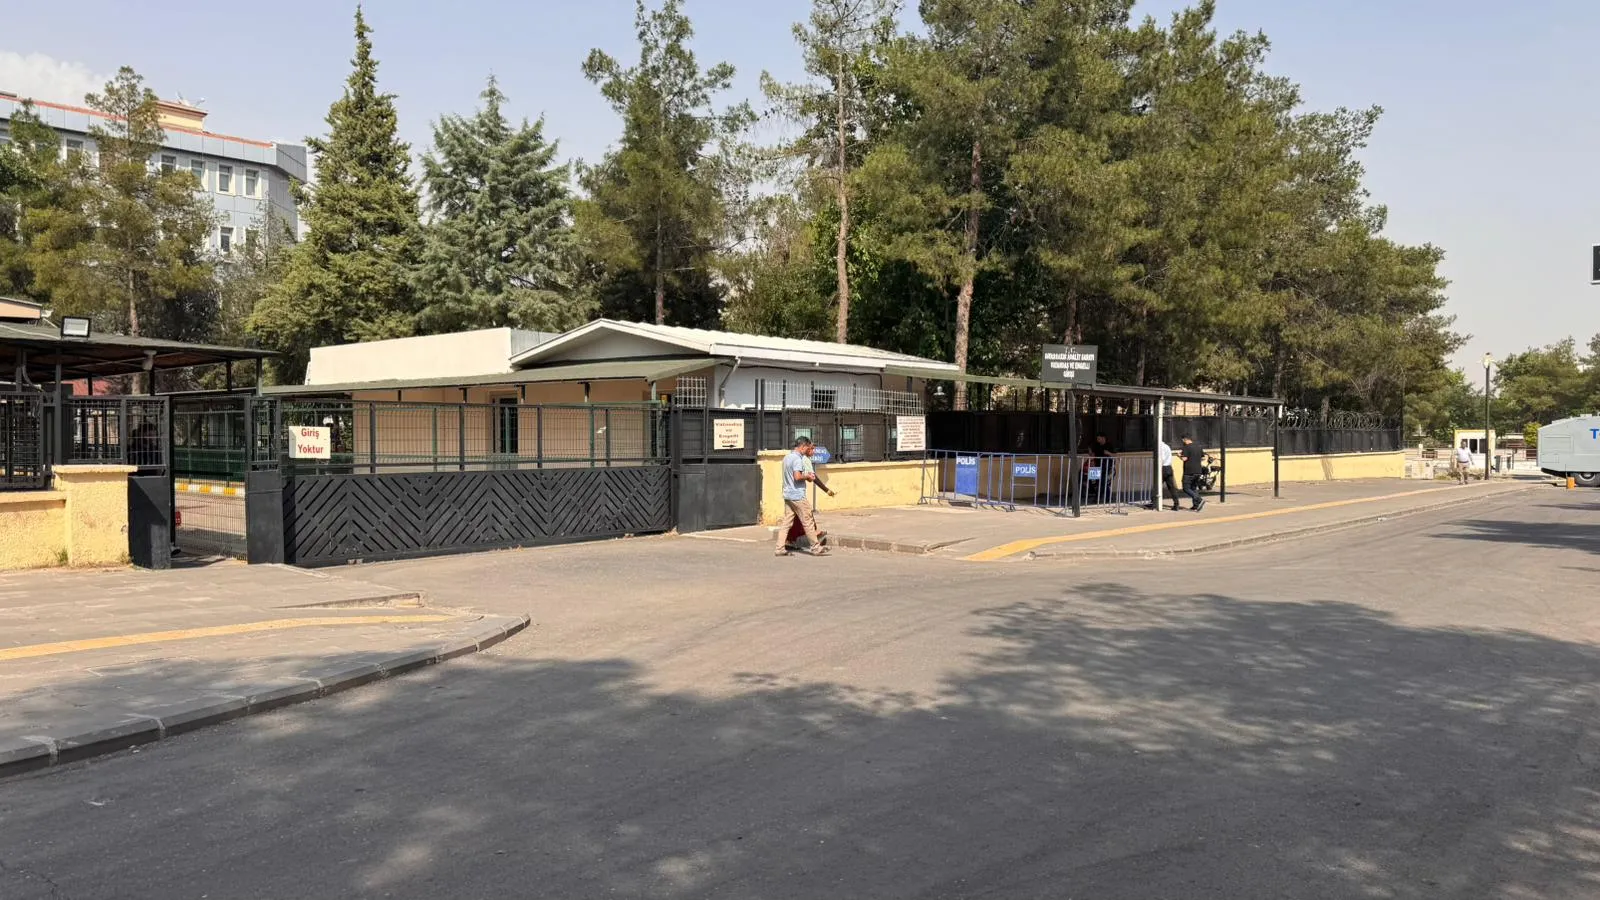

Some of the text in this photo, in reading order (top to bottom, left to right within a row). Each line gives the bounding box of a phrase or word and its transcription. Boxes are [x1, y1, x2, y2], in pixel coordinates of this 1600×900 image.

[301, 427, 320, 440] Giriş
[1589, 428, 1600, 440] T
[297, 443, 324, 454] Yoktur
